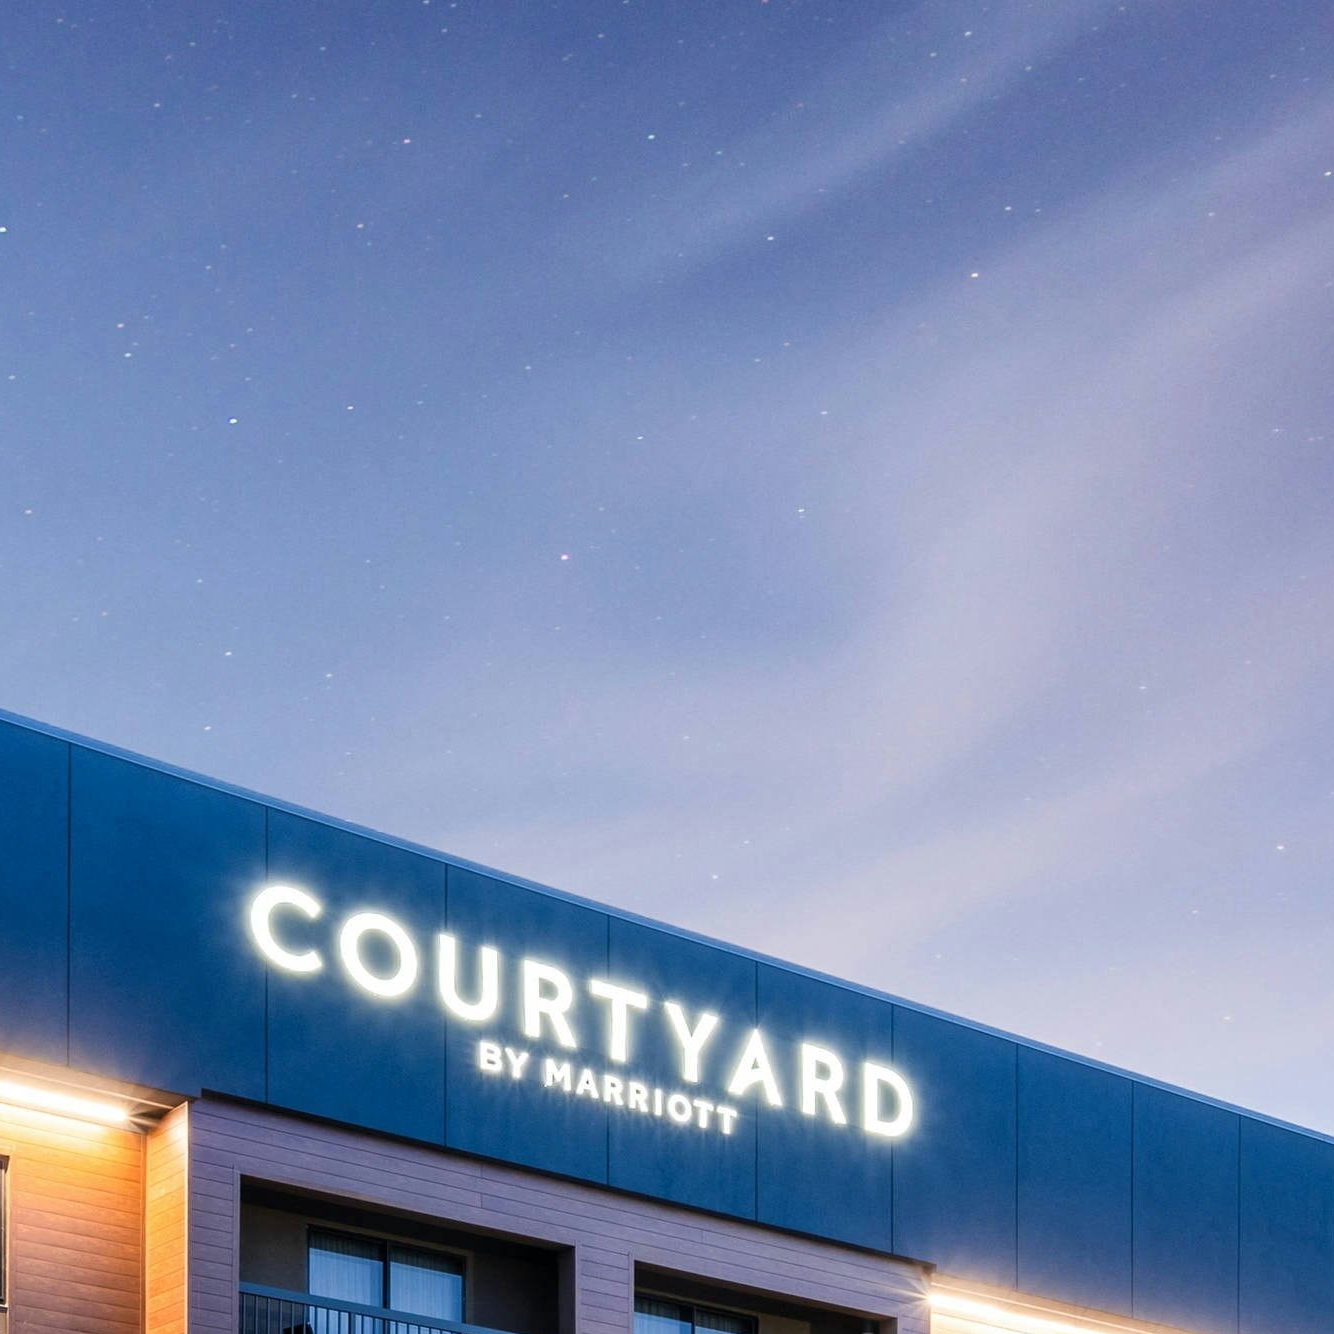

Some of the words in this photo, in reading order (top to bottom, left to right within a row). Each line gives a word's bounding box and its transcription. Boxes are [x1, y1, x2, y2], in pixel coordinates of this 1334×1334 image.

[249, 884, 914, 1138] COURTYARD
[478, 1040, 530, 1079] BY
[544, 1058, 738, 1135] MARRIOTT
